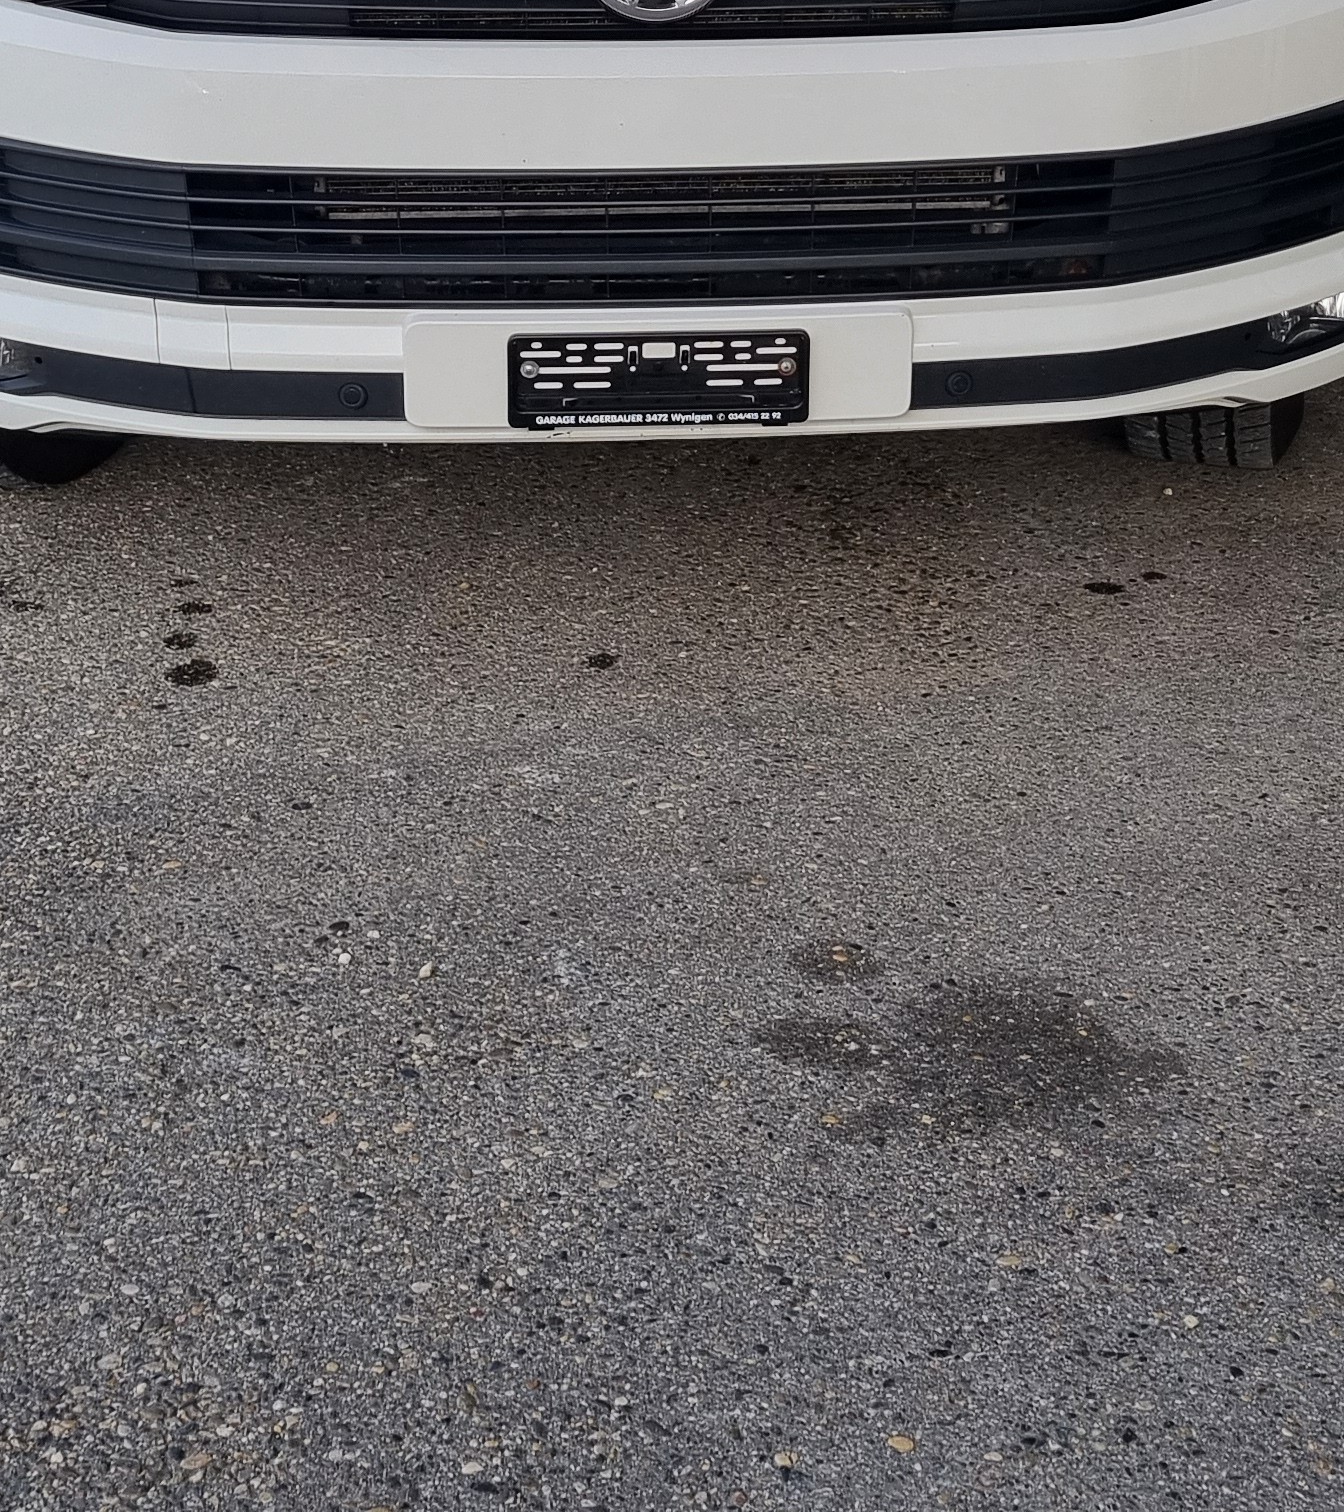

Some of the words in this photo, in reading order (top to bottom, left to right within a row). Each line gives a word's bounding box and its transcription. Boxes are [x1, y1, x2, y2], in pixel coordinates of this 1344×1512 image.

[535, 415, 576, 425] GARAGE
[578, 414, 643, 424] KAGERBAUER
[645, 413, 668, 423] 3472
[671, 412, 713, 424] Wynigen
[760, 412, 770, 420] 22
[771, 411, 782, 420] 92
